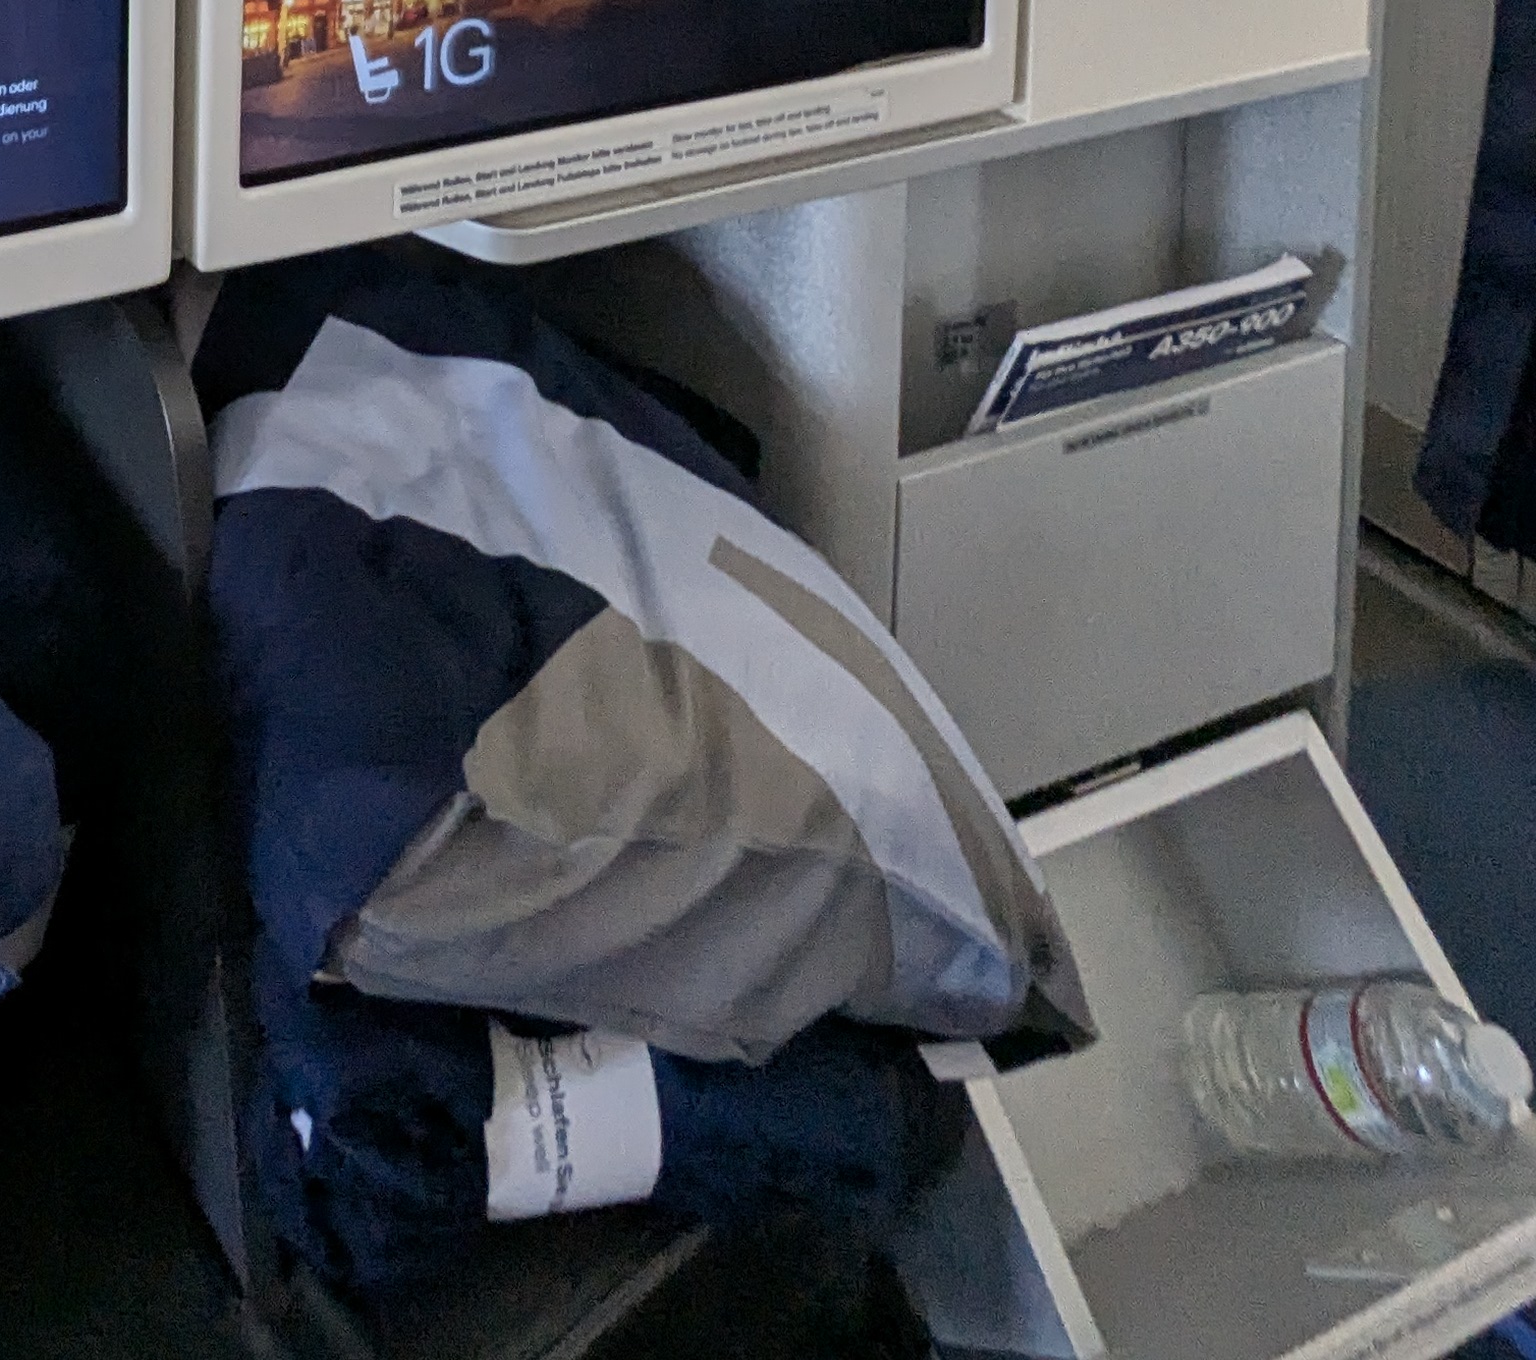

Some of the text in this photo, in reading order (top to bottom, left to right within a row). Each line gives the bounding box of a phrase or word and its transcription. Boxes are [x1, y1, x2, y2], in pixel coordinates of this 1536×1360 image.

[414, 18, 492, 91] 1G
[9, 79, 39, 95] oder
[2, 131, 19, 145] on
[21, 125, 50, 146] your
